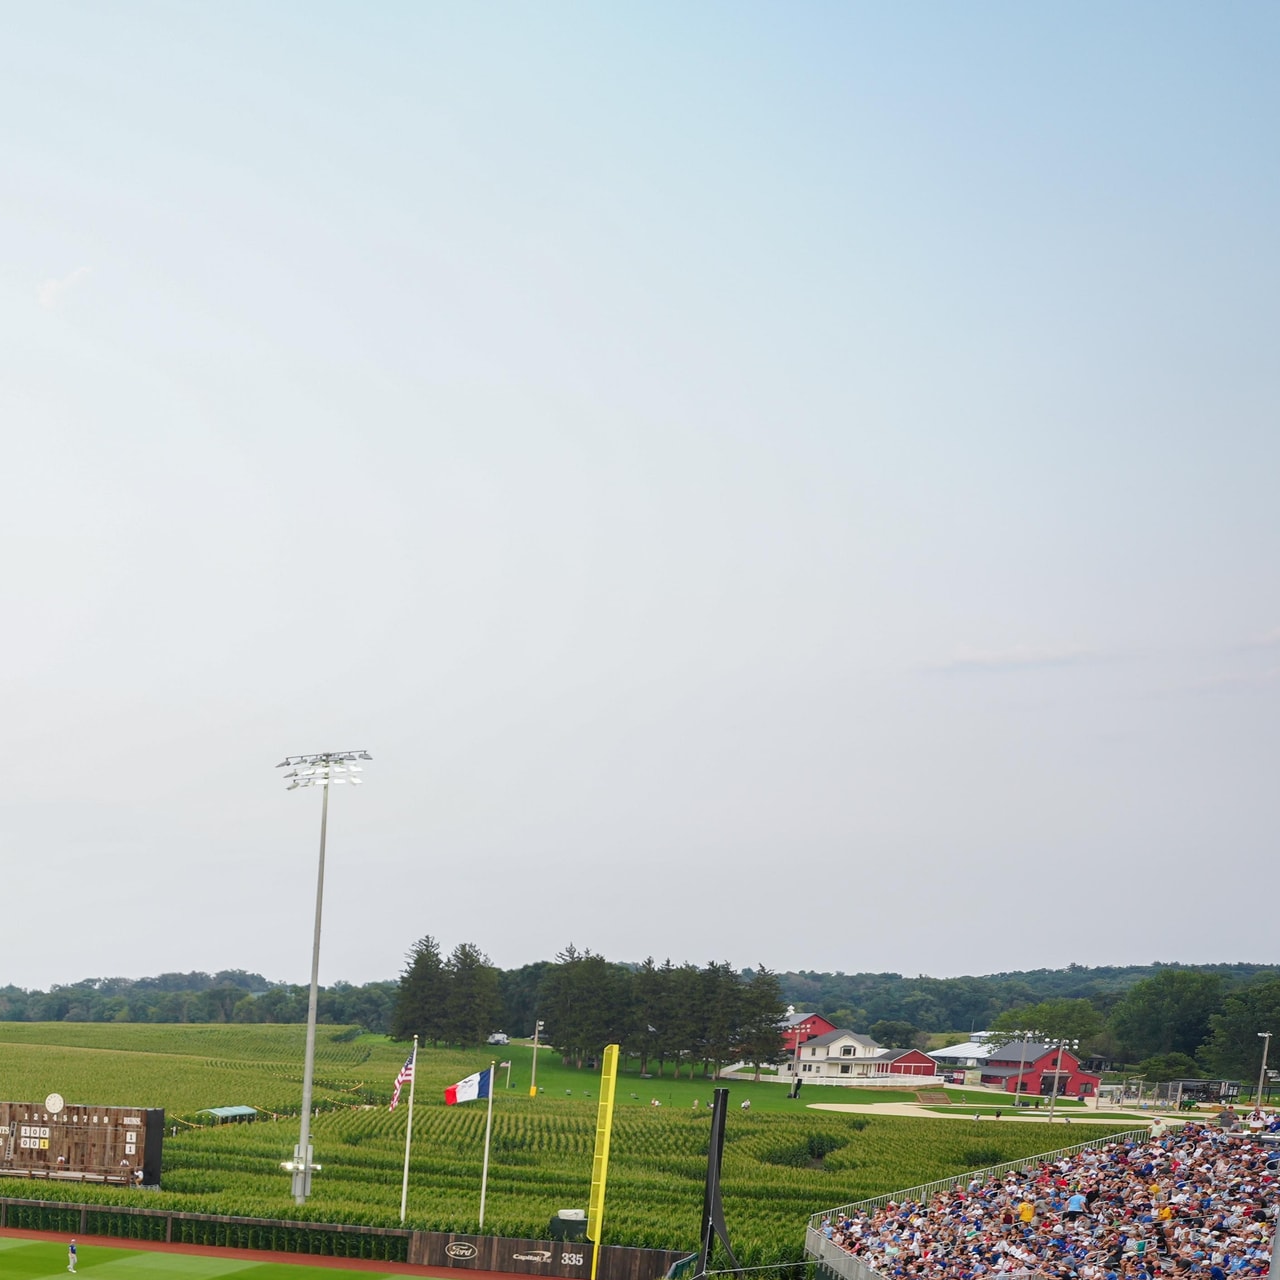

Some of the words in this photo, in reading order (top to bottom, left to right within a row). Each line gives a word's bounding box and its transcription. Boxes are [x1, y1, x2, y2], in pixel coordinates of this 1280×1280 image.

[450, 1245, 473, 1256] Ford
[513, 1254, 540, 1262] Capital
[561, 1253, 584, 1266] 335
